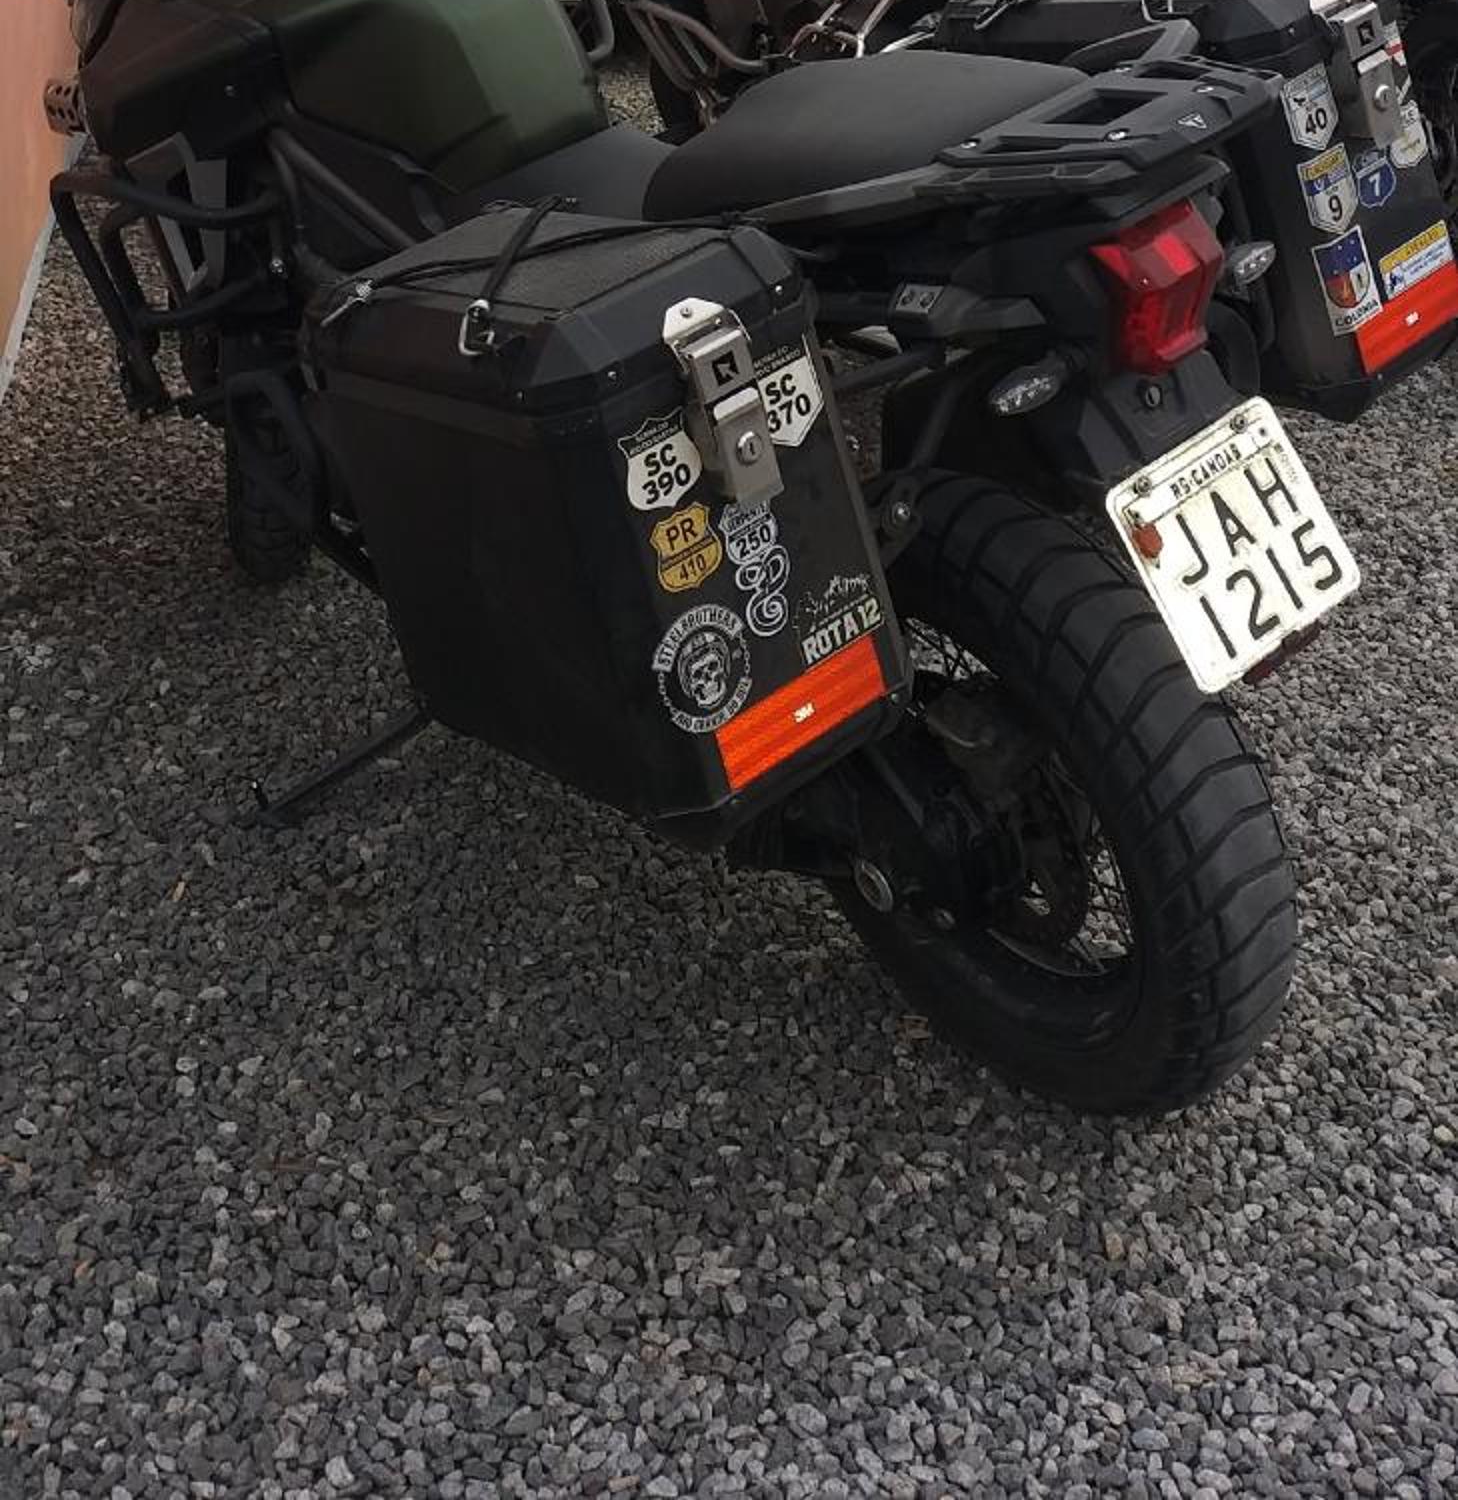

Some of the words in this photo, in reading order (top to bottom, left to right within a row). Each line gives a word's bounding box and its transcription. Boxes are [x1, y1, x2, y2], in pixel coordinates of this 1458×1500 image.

[1305, 107, 1328, 135] 40
[1367, 173, 1382, 197] 7
[1329, 195, 1344, 222] 9
[765, 373, 796, 405] SC
[767, 393, 811, 433] 370
[644, 443, 677, 477] SC
[642, 463, 691, 505] 390
[666, 518, 699, 550] PR
[1175, 457, 1302, 586] JAH
[736, 525, 771, 557] 250
[679, 554, 708, 581] 410
[1199, 519, 1343, 659] 1215
[857, 597, 882, 629] 12
